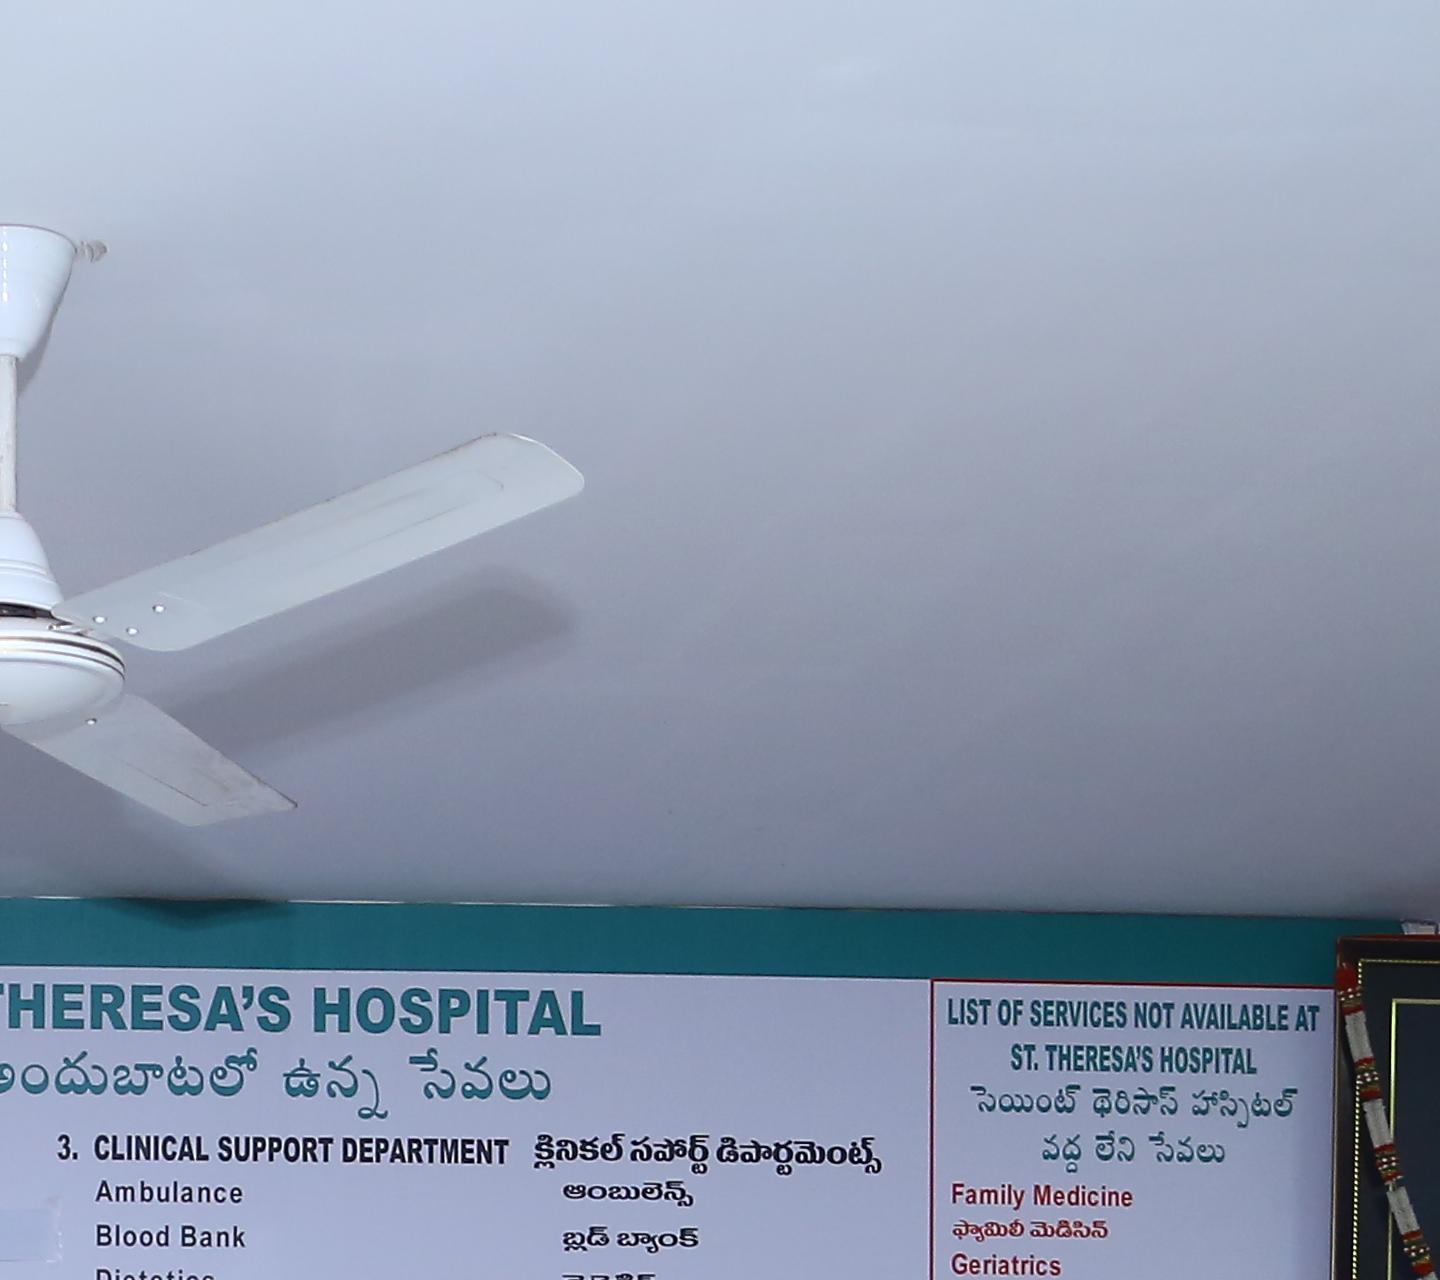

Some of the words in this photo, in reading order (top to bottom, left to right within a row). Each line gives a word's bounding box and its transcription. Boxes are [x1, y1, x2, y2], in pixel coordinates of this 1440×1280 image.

[313, 988, 602, 1036] HOSPITAL
[948, 997, 991, 1027] LIST
[996, 997, 1023, 1026] OF
[1030, 1000, 1127, 1028] SERVICES
[1134, 1002, 1175, 1029] NOT
[1180, 1003, 1289, 1031] AVAILABLE
[1295, 1005, 1320, 1032] AT
[1011, 1043, 1038, 1071] ST.
[1160, 1046, 1257, 1074] HOSPITAL
[58, 1134, 78, 1160] 3.
[94, 1135, 209, 1161] CLINICAL
[218, 1136, 334, 1163] SUPPORT
[342, 1137, 509, 1164] DEPARTMENT
[95, 1180, 242, 1203] Ambulance
[952, 1183, 1025, 1211] Family
[1034, 1185, 1133, 1207] Medicine
[97, 1224, 169, 1247] Blood
[181, 1225, 245, 1247] Bank
[952, 1253, 1061, 1276] Geriatrics
